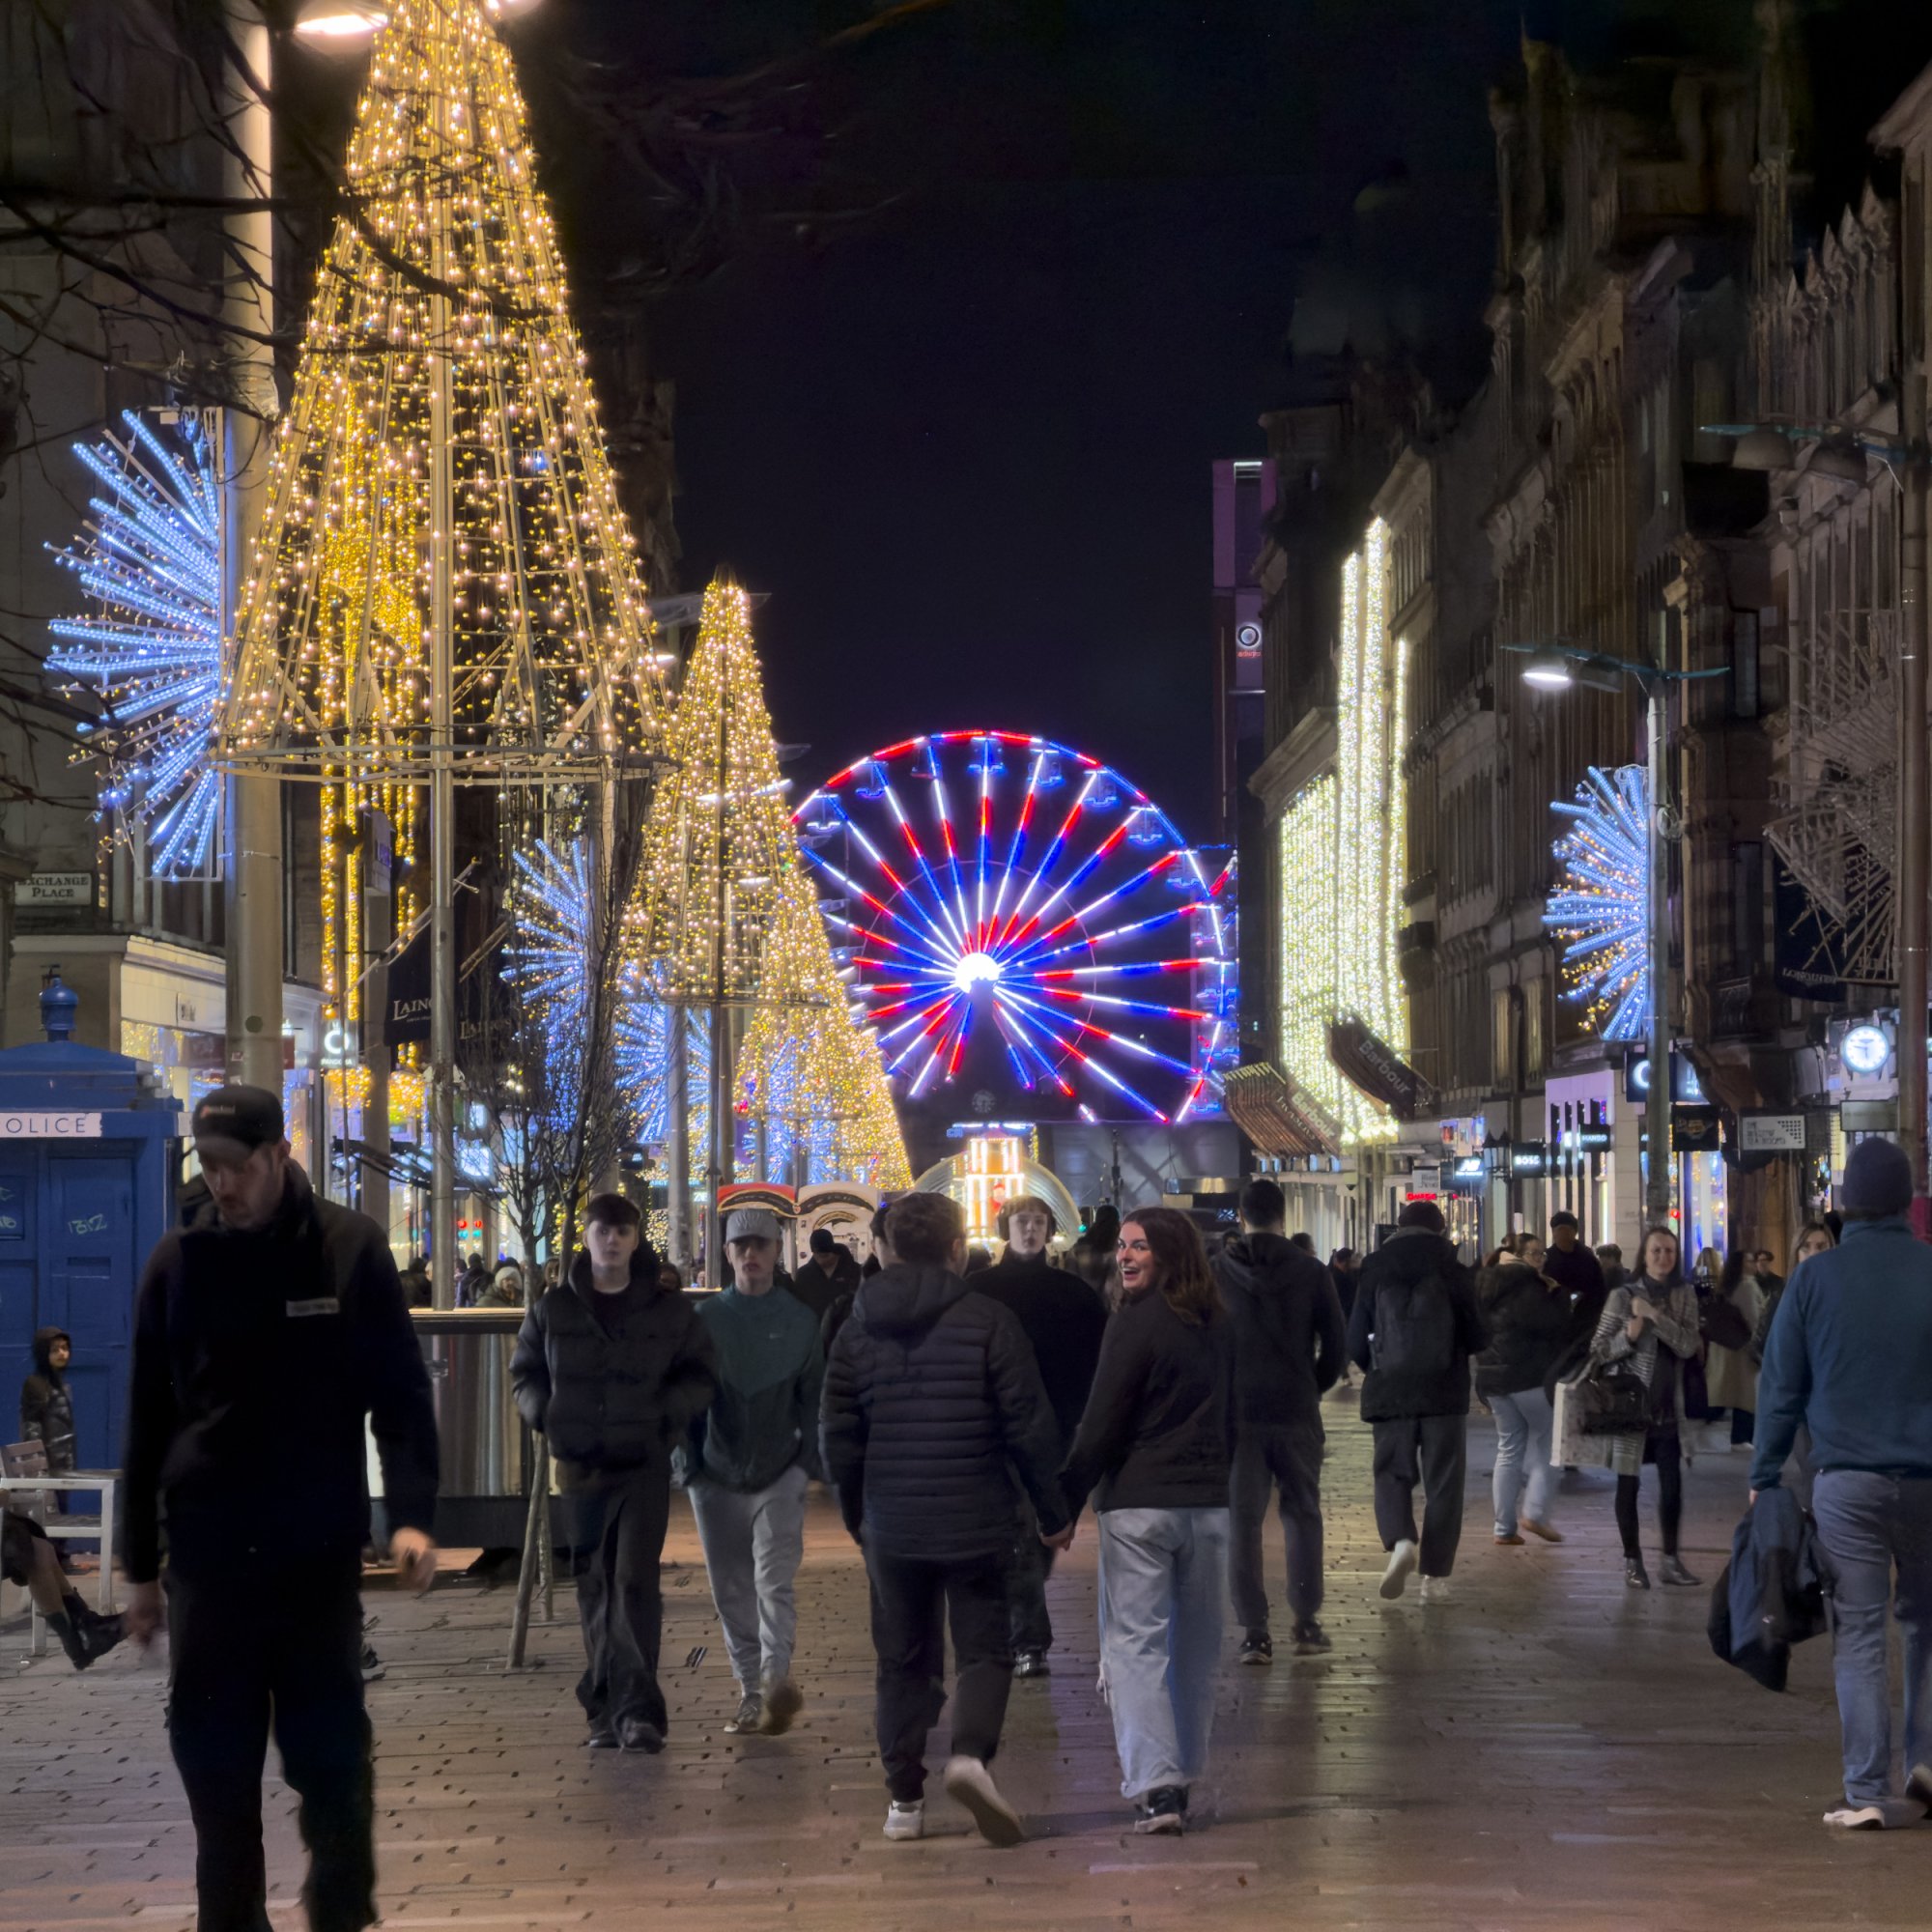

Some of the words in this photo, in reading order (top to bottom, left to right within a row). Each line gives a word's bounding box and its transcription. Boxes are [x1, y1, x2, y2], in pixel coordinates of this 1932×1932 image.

[32, 887, 74, 898] PLACE
[1359, 1039, 1411, 1094] Barbour
[1292, 1091, 1336, 1139] Barbour
[6, 1118, 86, 1134] OLICE
[1514, 1154, 1541, 1166] BOSS
